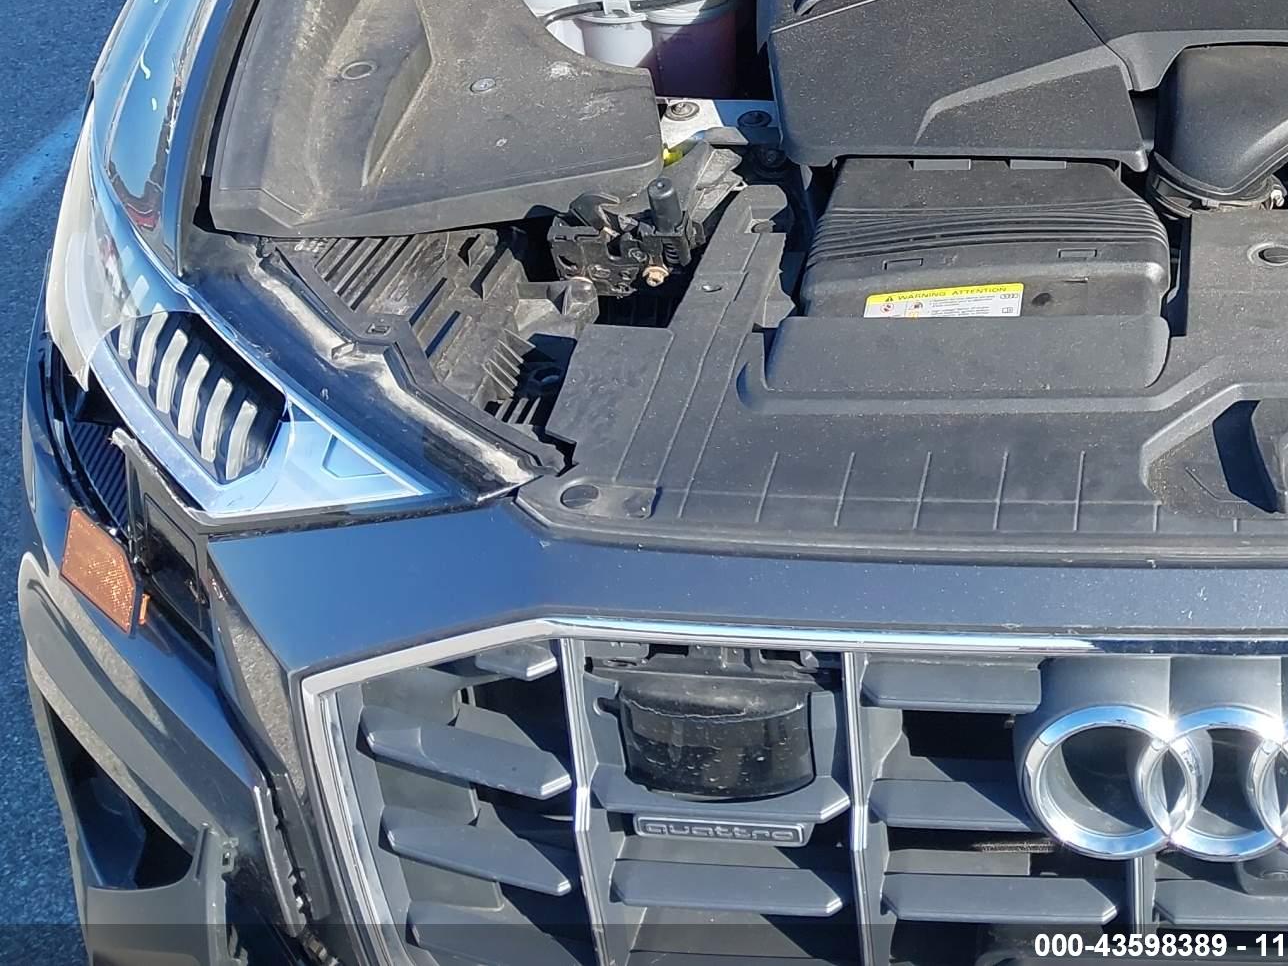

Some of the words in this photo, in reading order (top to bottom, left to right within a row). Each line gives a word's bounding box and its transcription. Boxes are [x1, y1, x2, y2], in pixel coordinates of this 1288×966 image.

[898, 291, 946, 301] WARNING
[952, 287, 1008, 295] ATTENTION
[646, 824, 794, 840] quattro
